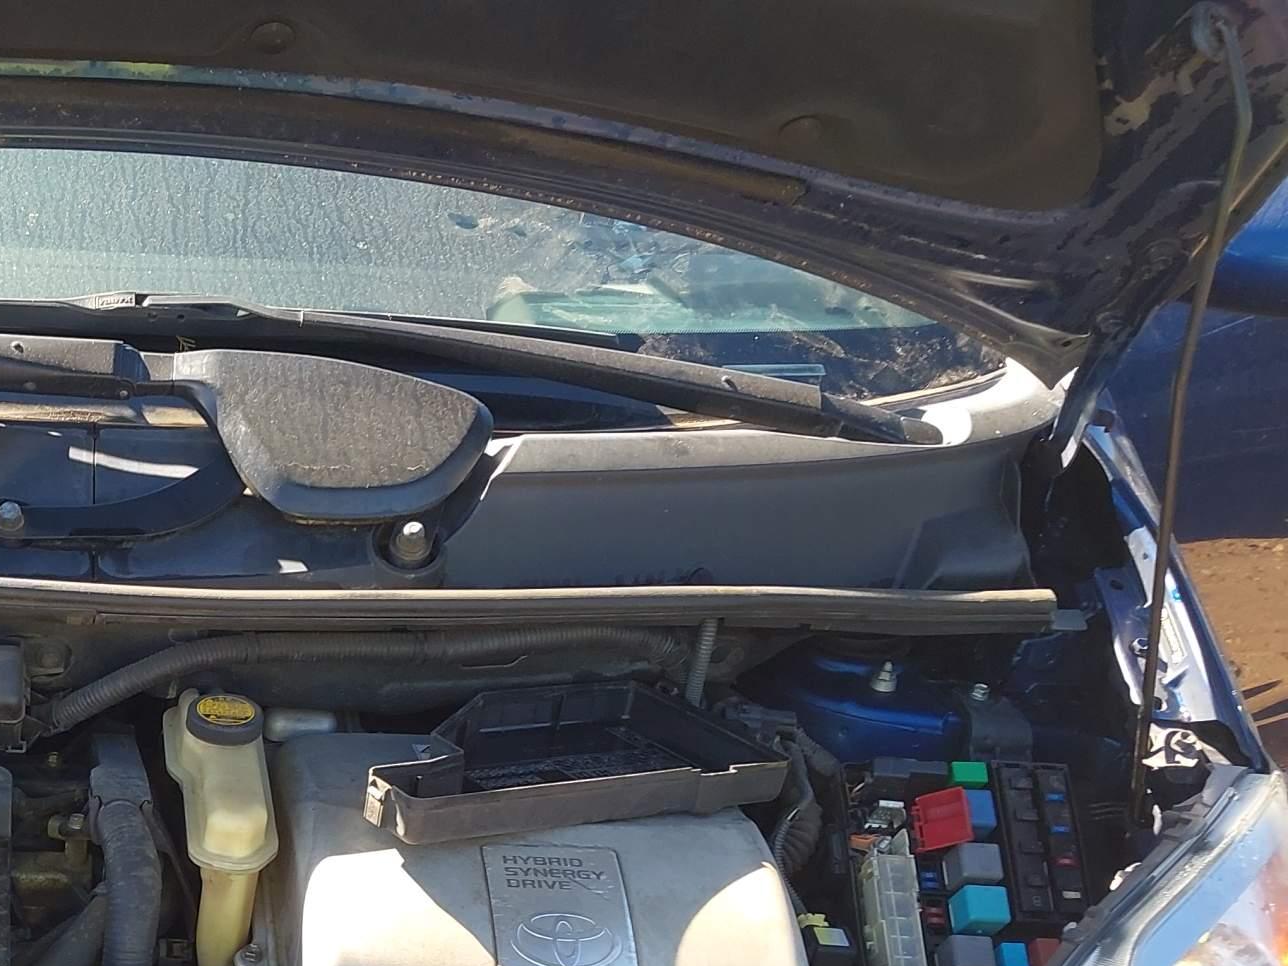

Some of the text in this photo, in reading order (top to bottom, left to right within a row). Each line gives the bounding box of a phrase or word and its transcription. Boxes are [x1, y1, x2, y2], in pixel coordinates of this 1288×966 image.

[503, 855, 583, 867] HYBRID
[504, 866, 605, 880] SYNERGY
[506, 878, 572, 890] DRIVE
